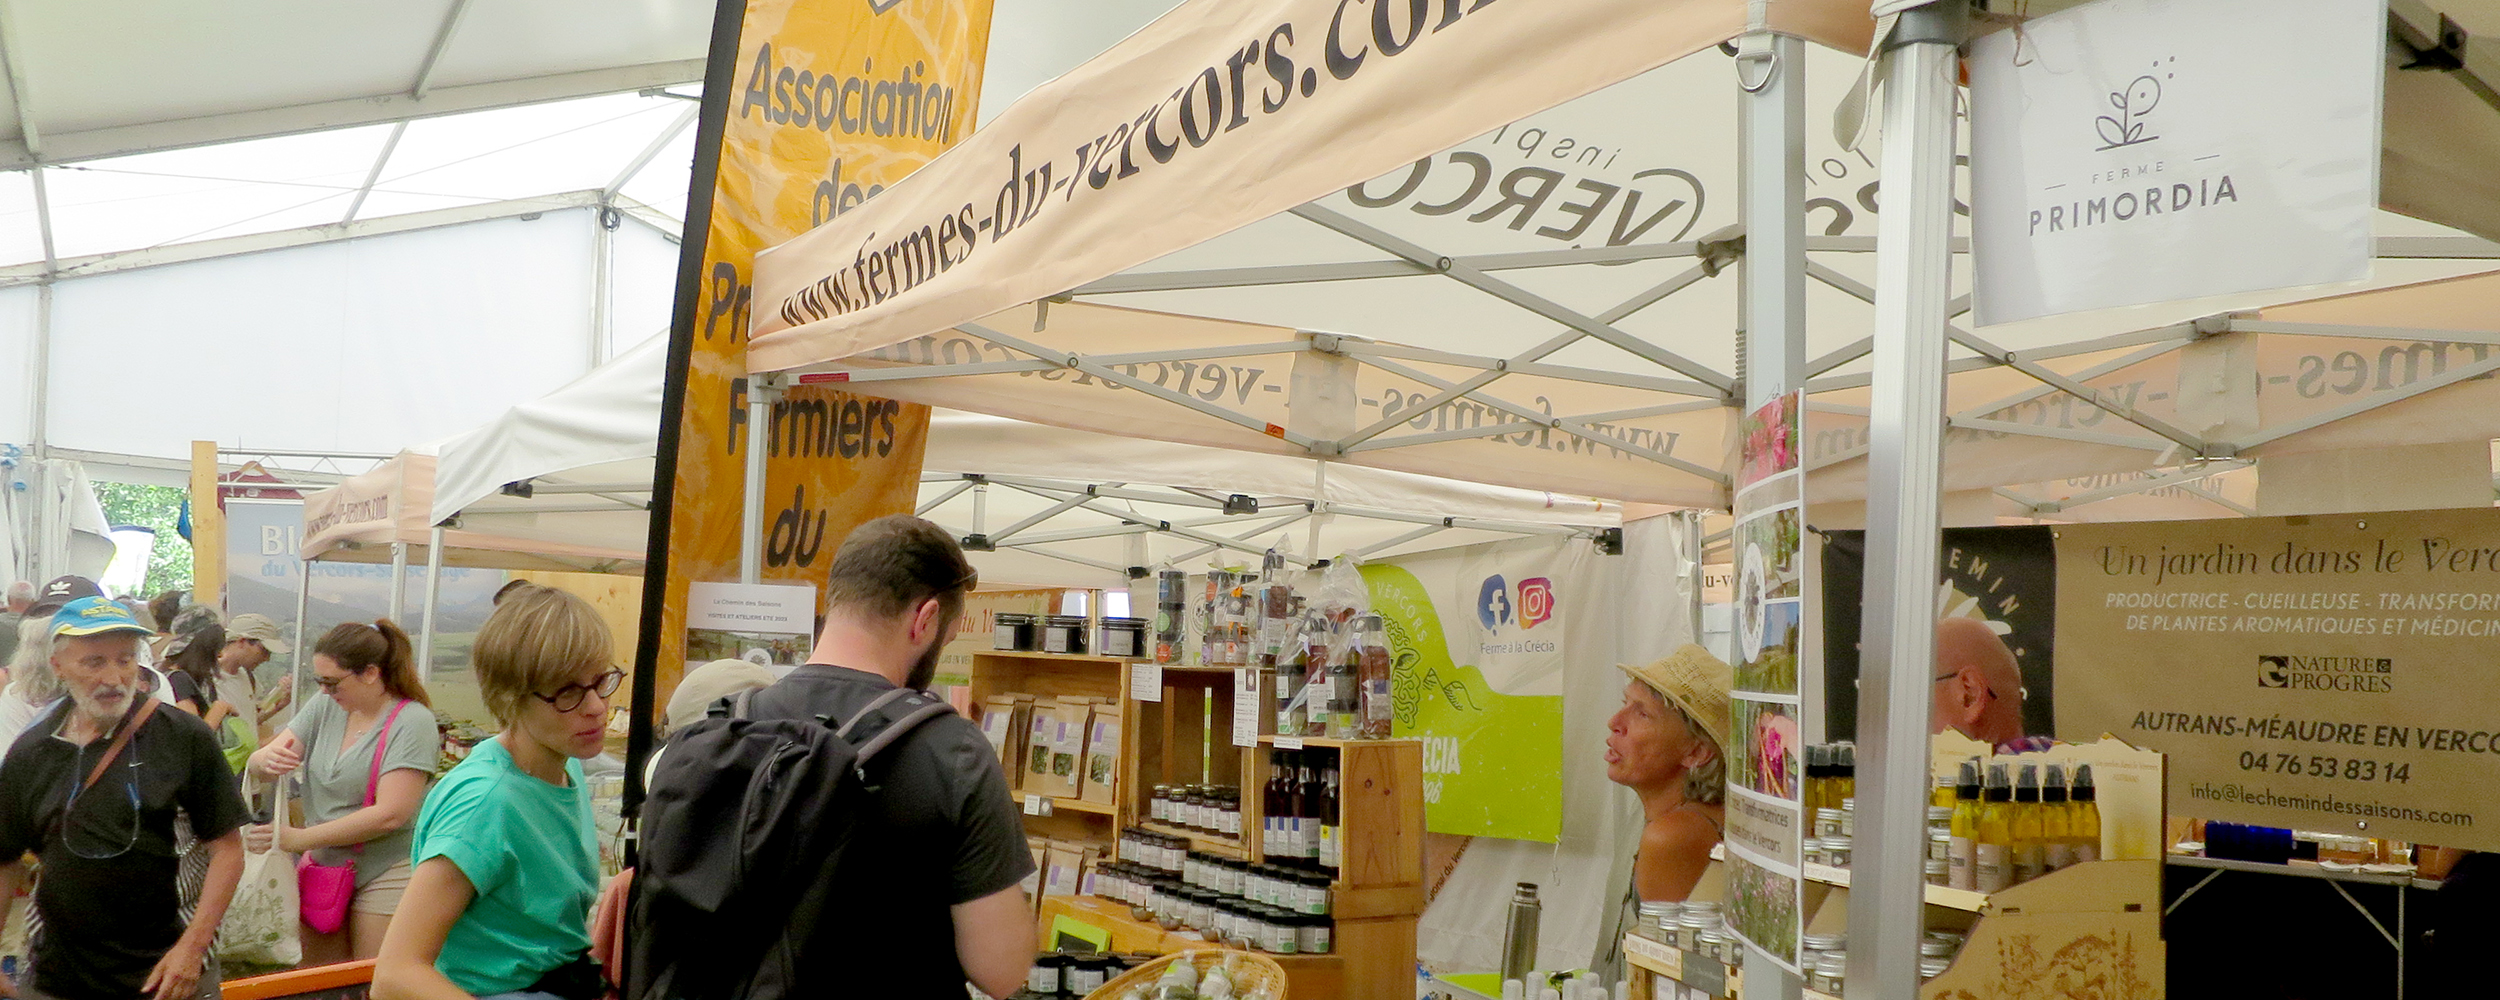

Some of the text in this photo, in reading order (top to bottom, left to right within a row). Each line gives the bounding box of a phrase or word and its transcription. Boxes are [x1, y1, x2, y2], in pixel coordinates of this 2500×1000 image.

[741, 42, 953, 144] Association
[2091, 161, 2164, 185] FERME
[2029, 174, 2238, 237] PRIMORDIA
[727, 377, 899, 459] Frmiers
[261, 525, 302, 555] Bl
[766, 483, 827, 568] du
[1949, 548, 2021, 616] EMIN
[2095, 544, 2147, 577] Un
[2155, 543, 2257, 586] jardin
[2271, 542, 2360, 575] dans
[2374, 538, 2404, 574] le
[1376, 581, 1428, 642] VERCORS
[2105, 593, 2229, 610] PRODUCTRICE
[2244, 593, 2360, 610] CUEILLEUSE
[2126, 616, 2150, 631] DE
[2151, 615, 2228, 632] PLANTES
[2232, 616, 2377, 635] AROMATIQUES
[2382, 618, 2404, 636] ET
[1480, 642, 1507, 655] Ferme
[1524, 639, 1555, 653] Crécia
[2291, 655, 2375, 673] NATURE
[2291, 672, 2392, 693] PROGRES
[2132, 711, 2367, 746] AUTRANS-MÉAUDRE
[2374, 725, 2409, 749] EN
[1406, 730, 1461, 775] ÉCIA
[2239, 751, 2411, 784] 04 76 53 83 14
[2190, 783, 2473, 827] info@lechemindessaisons.com
